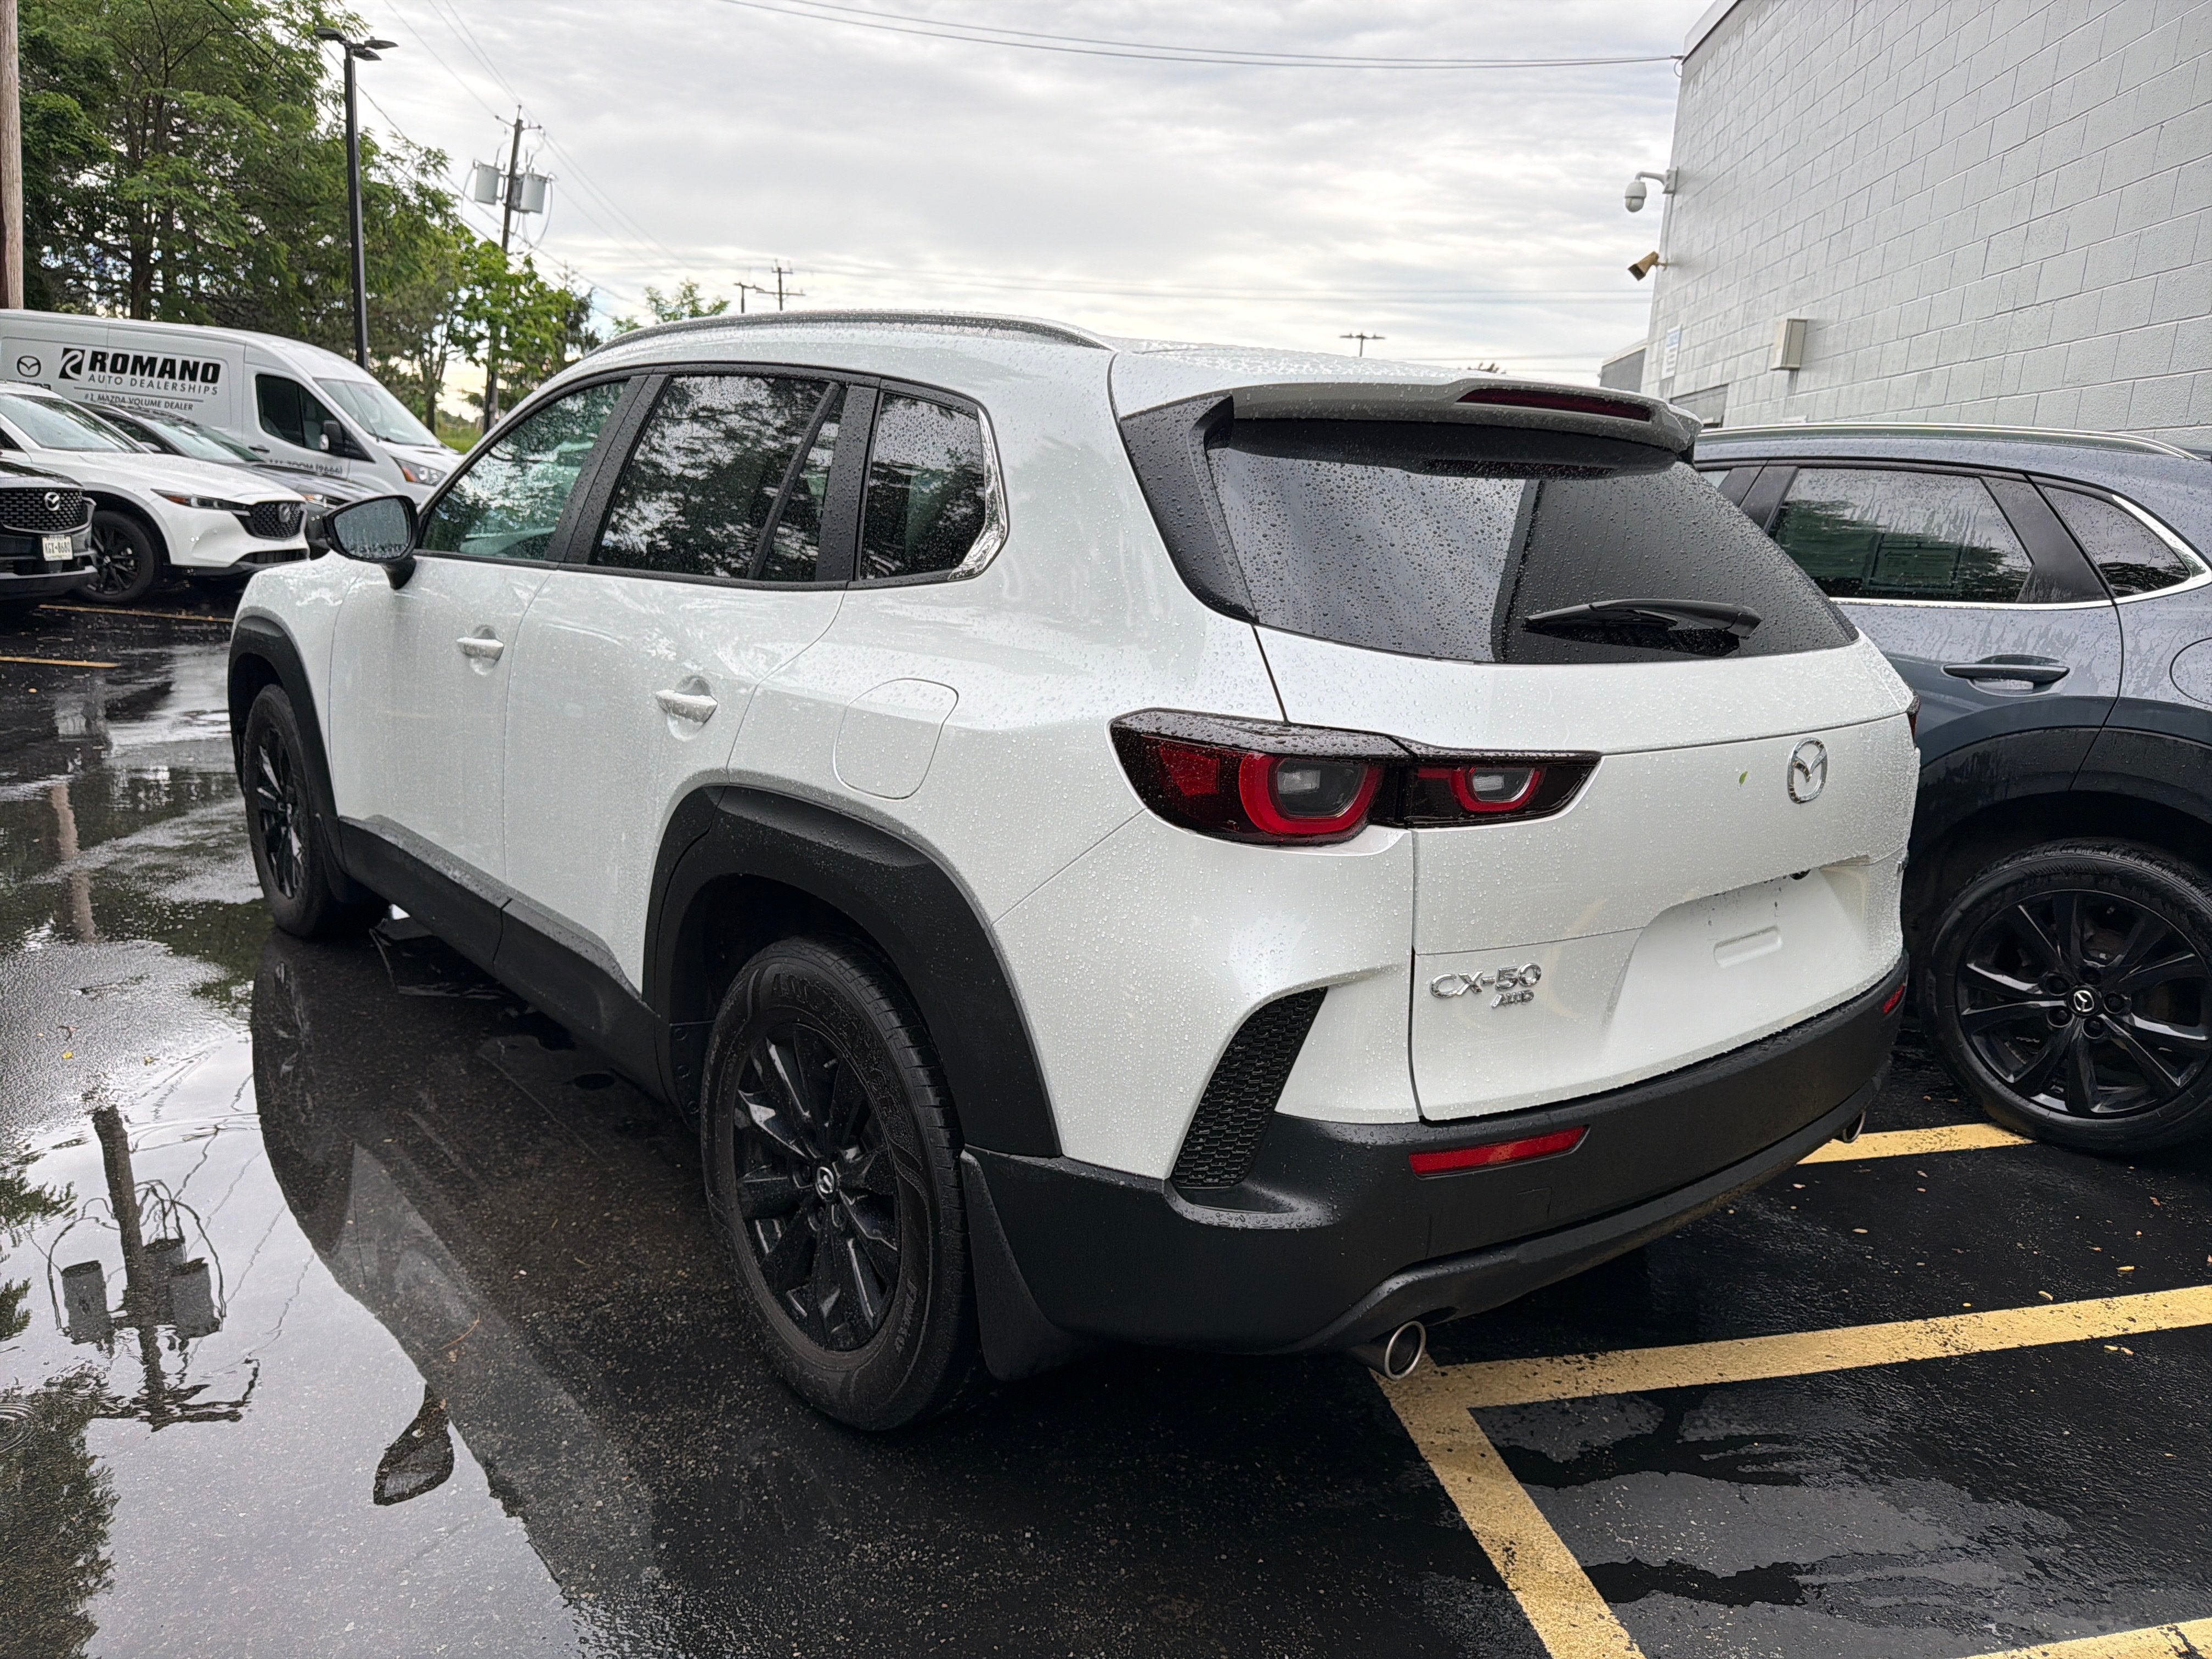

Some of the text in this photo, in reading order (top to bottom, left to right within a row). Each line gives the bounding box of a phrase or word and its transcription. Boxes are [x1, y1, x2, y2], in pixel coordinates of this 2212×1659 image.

[88, 351, 221, 383] ROMANO
[88, 374, 218, 396] AUTO DEALERSHIPS
[84, 393, 193, 411] #1 MAZDA VOLUME DEALER
[1430, 962, 1542, 998] CX-50
[1491, 989, 1535, 1009] AWD
